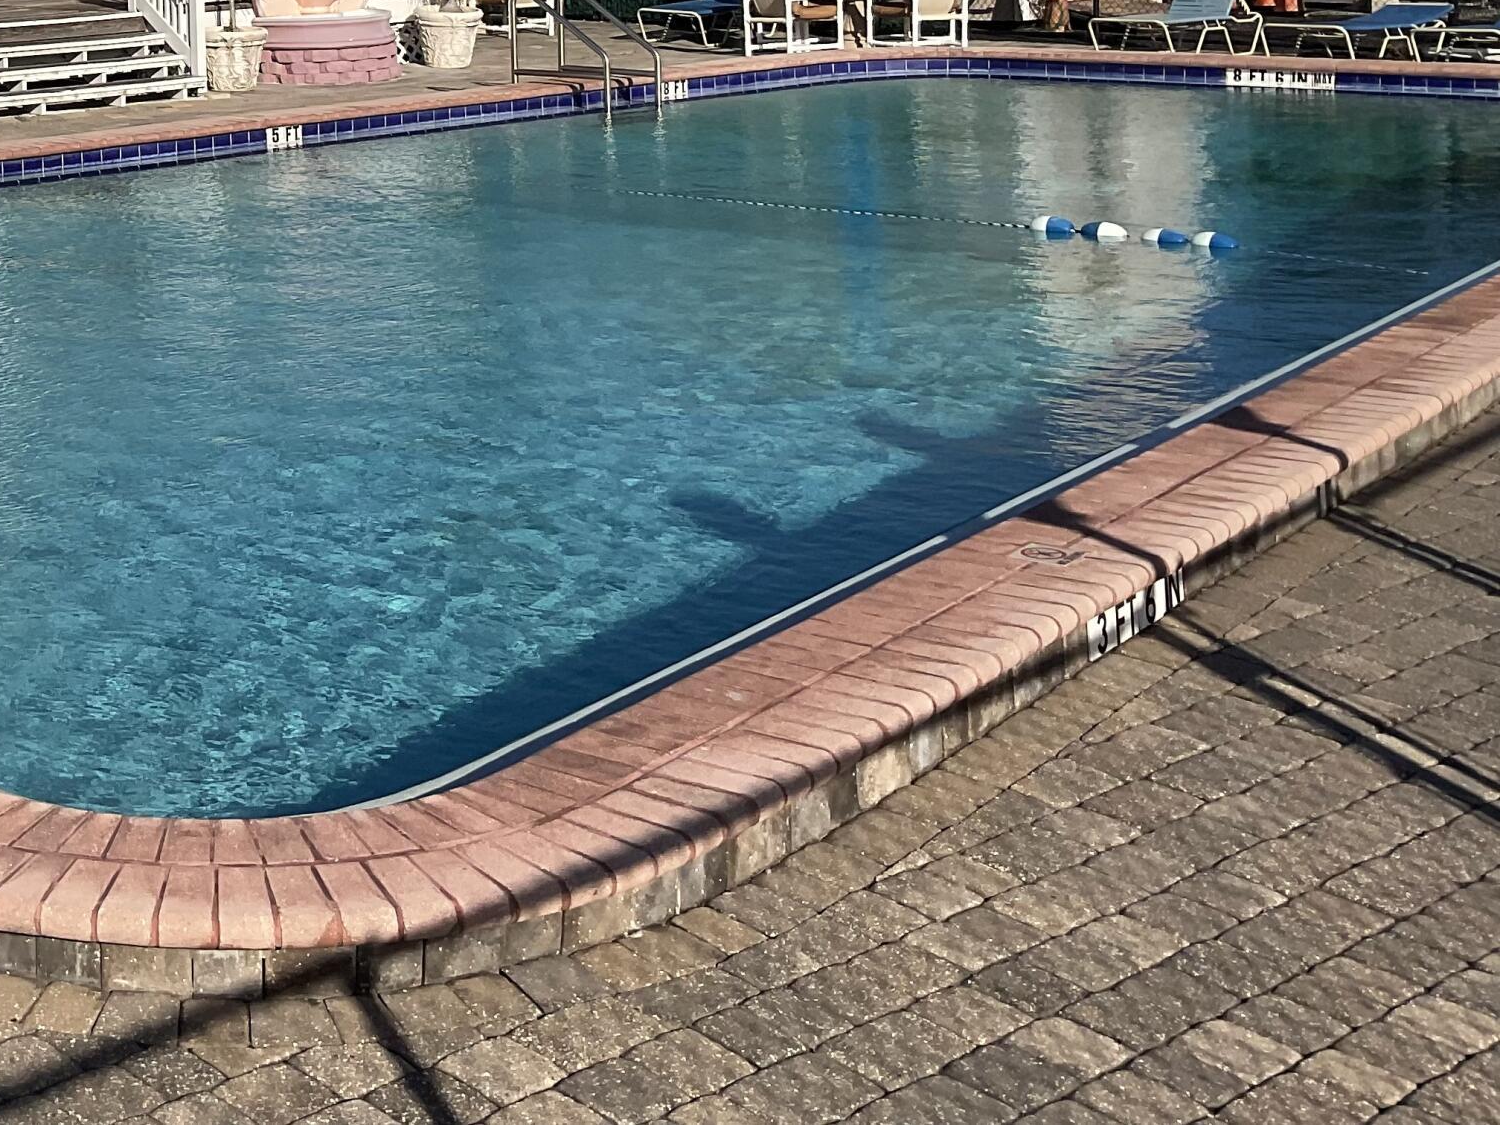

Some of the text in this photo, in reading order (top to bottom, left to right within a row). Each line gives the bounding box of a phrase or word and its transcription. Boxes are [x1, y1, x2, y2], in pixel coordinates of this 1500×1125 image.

[1233, 69, 1242, 82] 8
[1249, 69, 1267, 82] FT
[1275, 71, 1284, 84] 6
[1292, 72, 1307, 83] IN
[663, 79, 686, 95] 8 FT
[272, 125, 299, 143] 5 FT
[1097, 612, 1108, 654] 3
[1115, 594, 1136, 646] FT
[1145, 584, 1156, 624] 6
